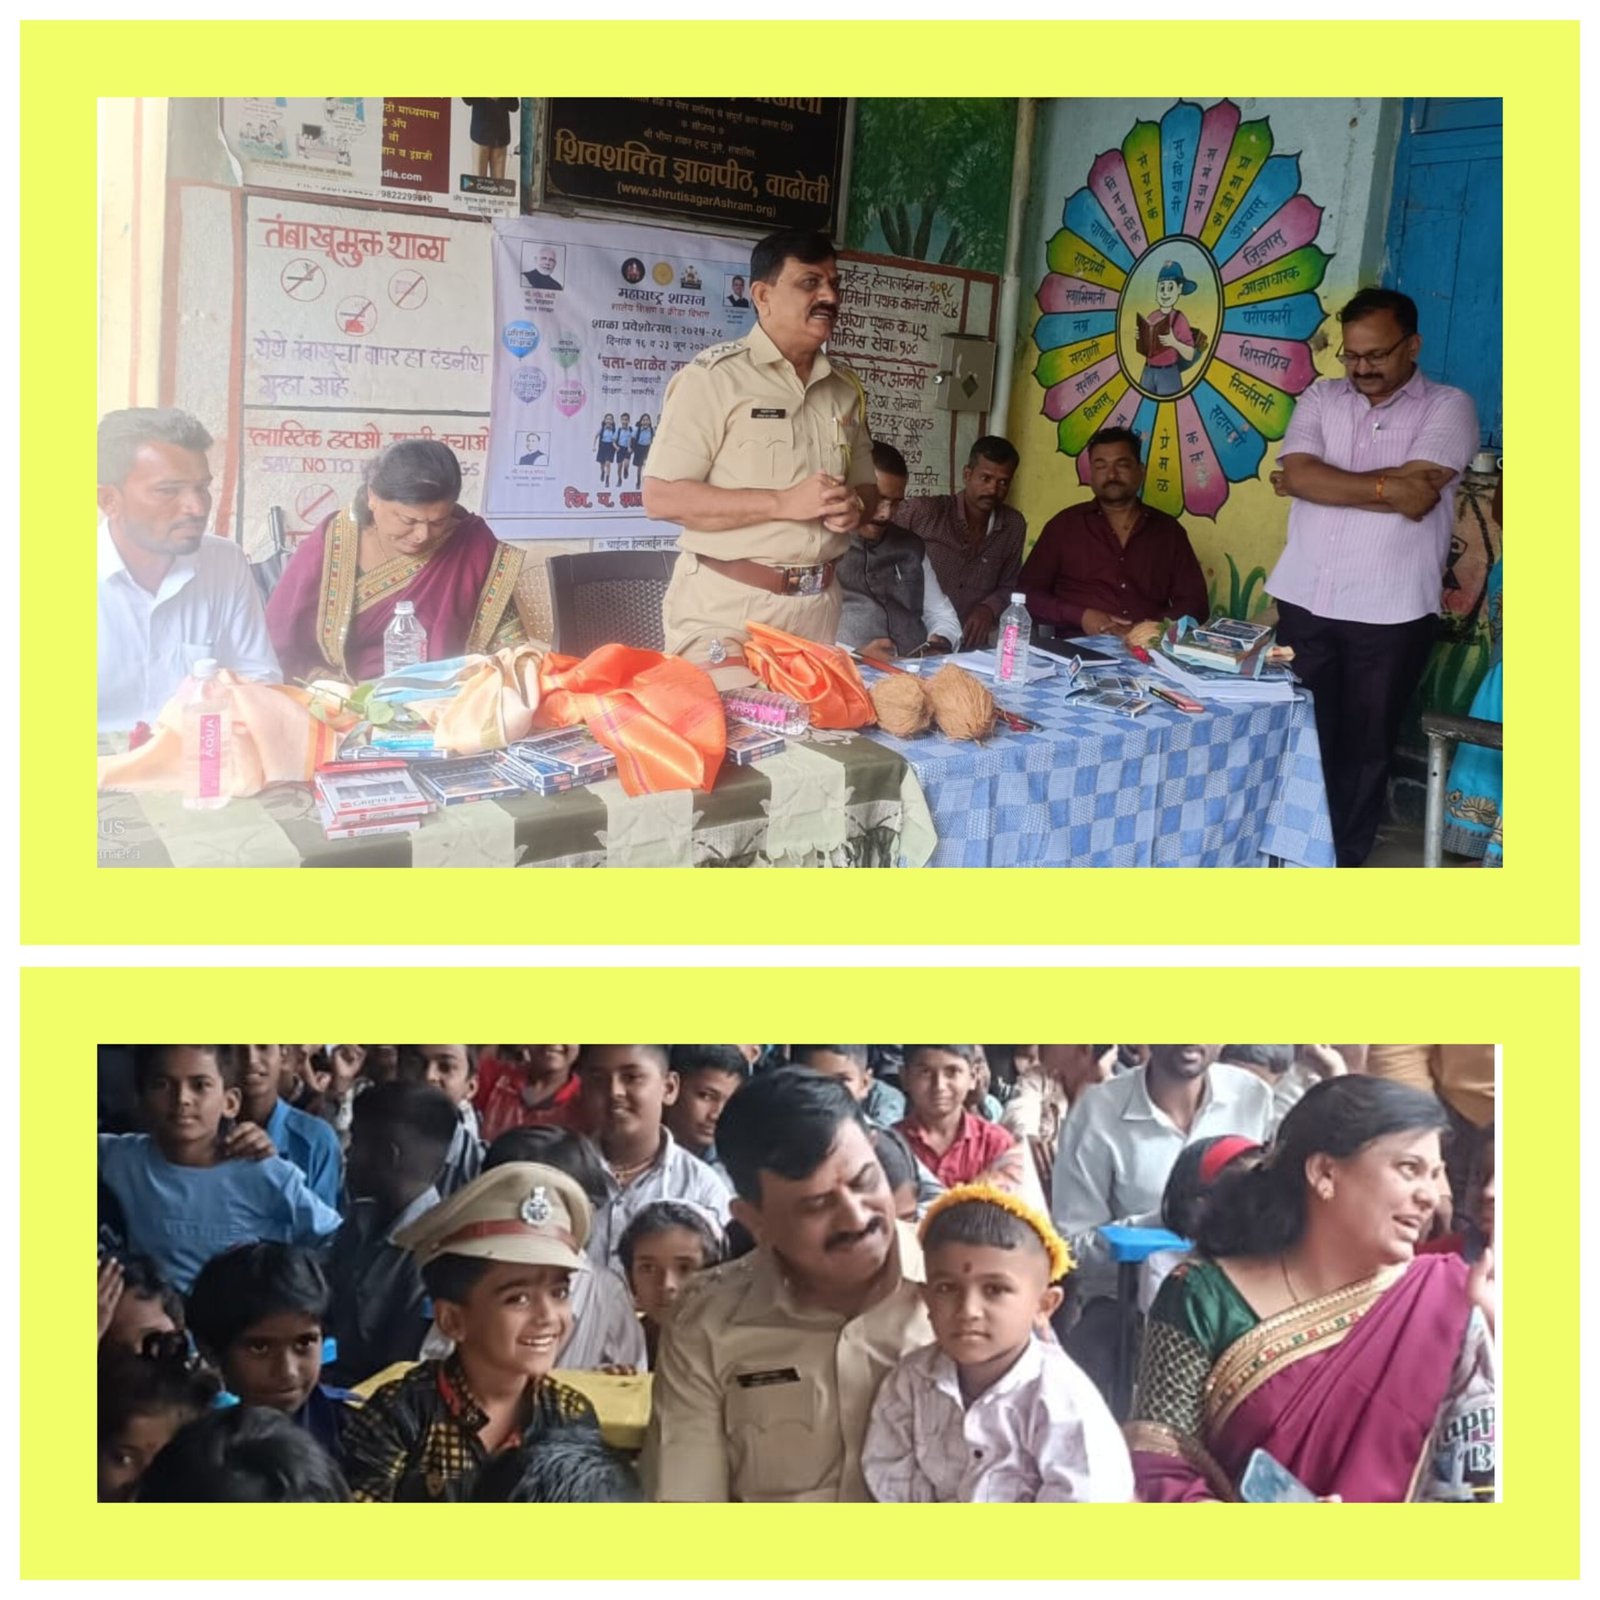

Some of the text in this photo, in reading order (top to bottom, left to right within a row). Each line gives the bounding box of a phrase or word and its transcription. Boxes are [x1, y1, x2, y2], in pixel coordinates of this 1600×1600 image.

[554, 129, 667, 177] शिवशक्ति
[765, 169, 830, 205] वाढोली
[258, 213, 452, 269] तंबाखूमुक्त शाळा
[618, 287, 706, 307] महाराष्ट्र शासन
[838, 284, 870, 308] ामिनी
[591, 319, 619, 330] शाळा
[622, 318, 672, 335] प्रवेशोत्सव
[606, 333, 632, 346] दिनांक
[673, 341, 687, 353] जून
[301, 457, 326, 473] NO
[331, 457, 354, 473] TO
[205, 718, 215, 757] AQUA
